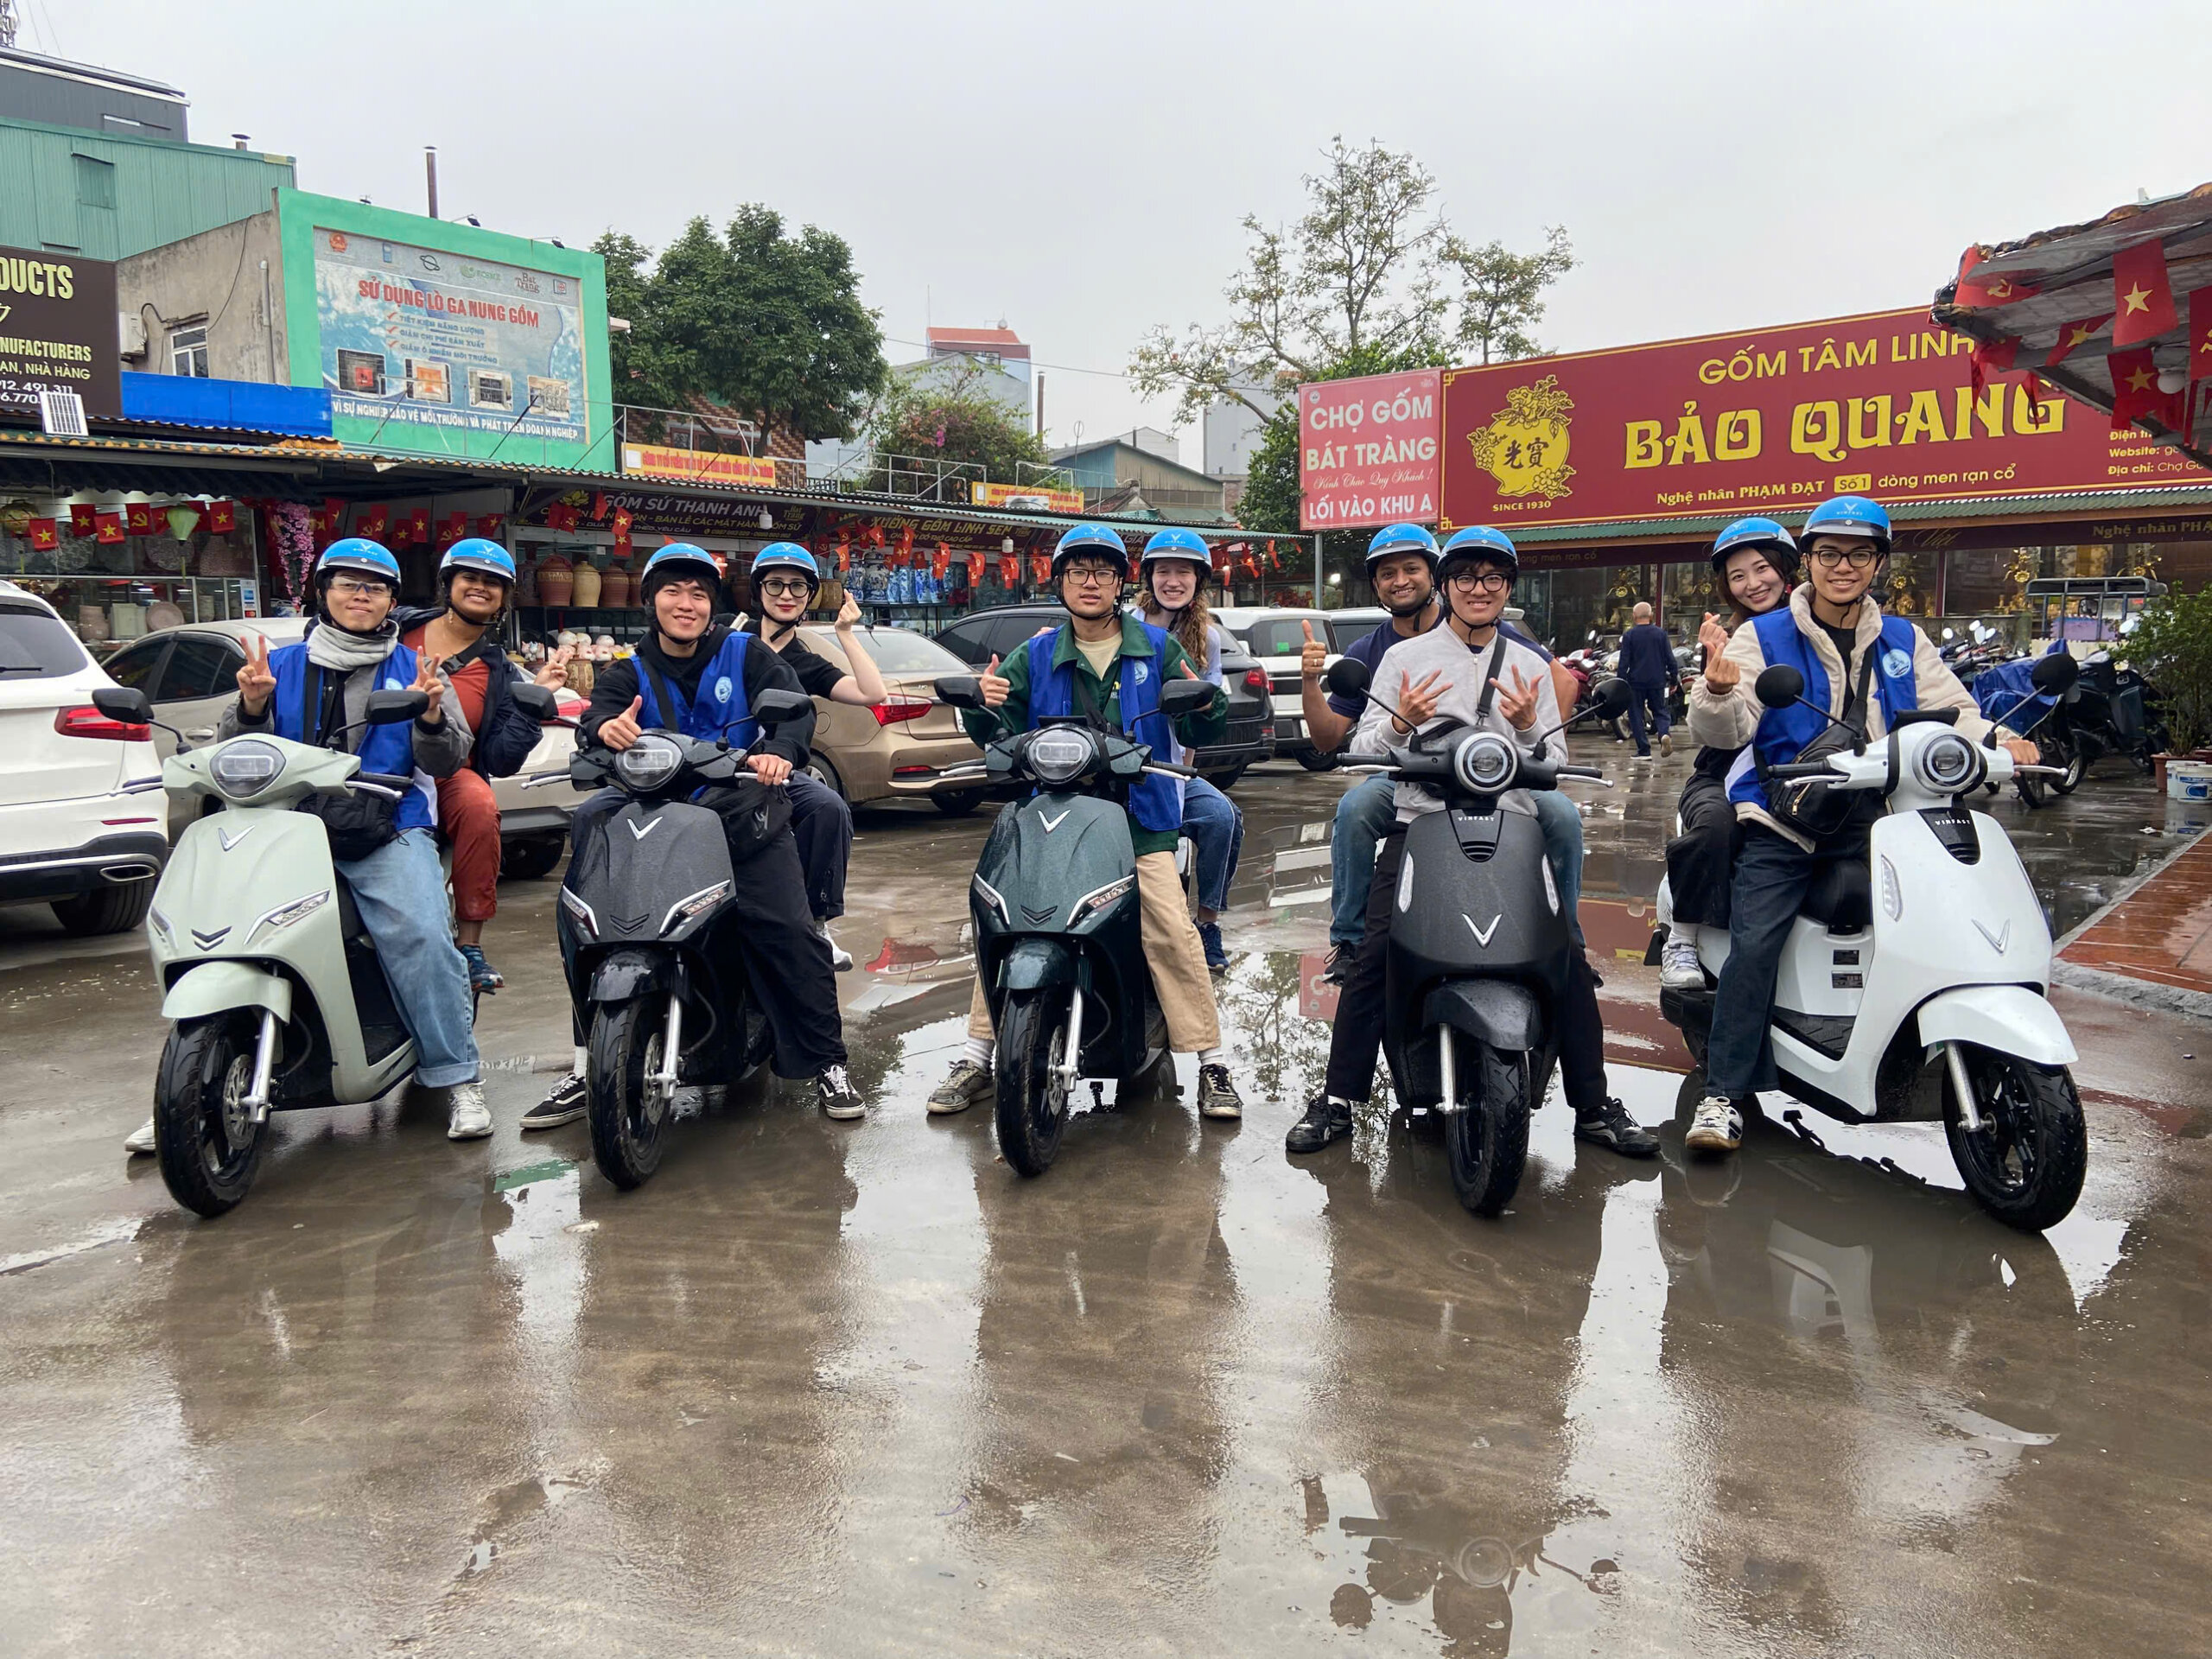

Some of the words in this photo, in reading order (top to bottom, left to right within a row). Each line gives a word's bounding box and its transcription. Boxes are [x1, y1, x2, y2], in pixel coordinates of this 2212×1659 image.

[359, 276, 381, 300] SỬ
[383, 284, 424, 308] DỤNG
[427, 289, 443, 311] LÒ
[448, 297, 467, 316] GA
[468, 301, 505, 321] NUNG
[509, 304, 539, 328] GỐM
[1699, 345, 1787, 385] GỐM
[1798, 337, 1877, 373] TÂM
[1891, 330, 1974, 362] LINH
[25, 360, 52, 377] NHÀ
[54, 363, 91, 379] HÀNG
[333, 399, 342, 413] VÌ
[343, 403, 355, 417] SỰ
[407, 410, 419, 424] VỆ
[471, 415, 480, 428] VÀ
[481, 416, 501, 431] PHÁT
[526, 424, 551, 437] DOANH
[552, 427, 578, 442] NGHIỆP
[1310, 399, 1364, 433] CHỢ
[1371, 387, 1433, 424] GỐM
[1624, 400, 1762, 469] BẢO
[1790, 378, 2066, 462] QUANG
[1306, 441, 1348, 472] BÁT
[1354, 435, 1437, 467] TRÀNG
[2109, 446, 2160, 458] Website:
[2107, 466, 2129, 477] Địa
[2132, 462, 2154, 474] chỉ:
[2158, 462, 2183, 473] Chợ
[1657, 489, 1694, 505] Nghệ
[1699, 488, 1734, 501] nhân
[1739, 484, 1786, 499] PHẠM
[1791, 480, 1825, 496] ĐẠT
[1840, 475, 1859, 490] Số
[1861, 477, 1867, 488] 1
[1878, 474, 1918, 489] dòng
[1923, 473, 1958, 485] men
[1962, 471, 1988, 485] rạn
[1993, 463, 2016, 480] cổ
[645, 495, 674, 510] SỨ
[676, 500, 731, 515] THANH
[1310, 493, 1333, 519] LỐI
[1339, 494, 1375, 518] VÀO
[1381, 495, 1414, 514] KHU
[1420, 493, 1433, 512] A
[1492, 503, 1523, 512] SINCE
[1527, 500, 1551, 510] 1930
[737, 520, 760, 530] HÀN
[953, 522, 985, 534] LINH
[986, 524, 1013, 535] SEN
[2093, 524, 2132, 539] Nghệ
[2138, 522, 2176, 534] nhân
